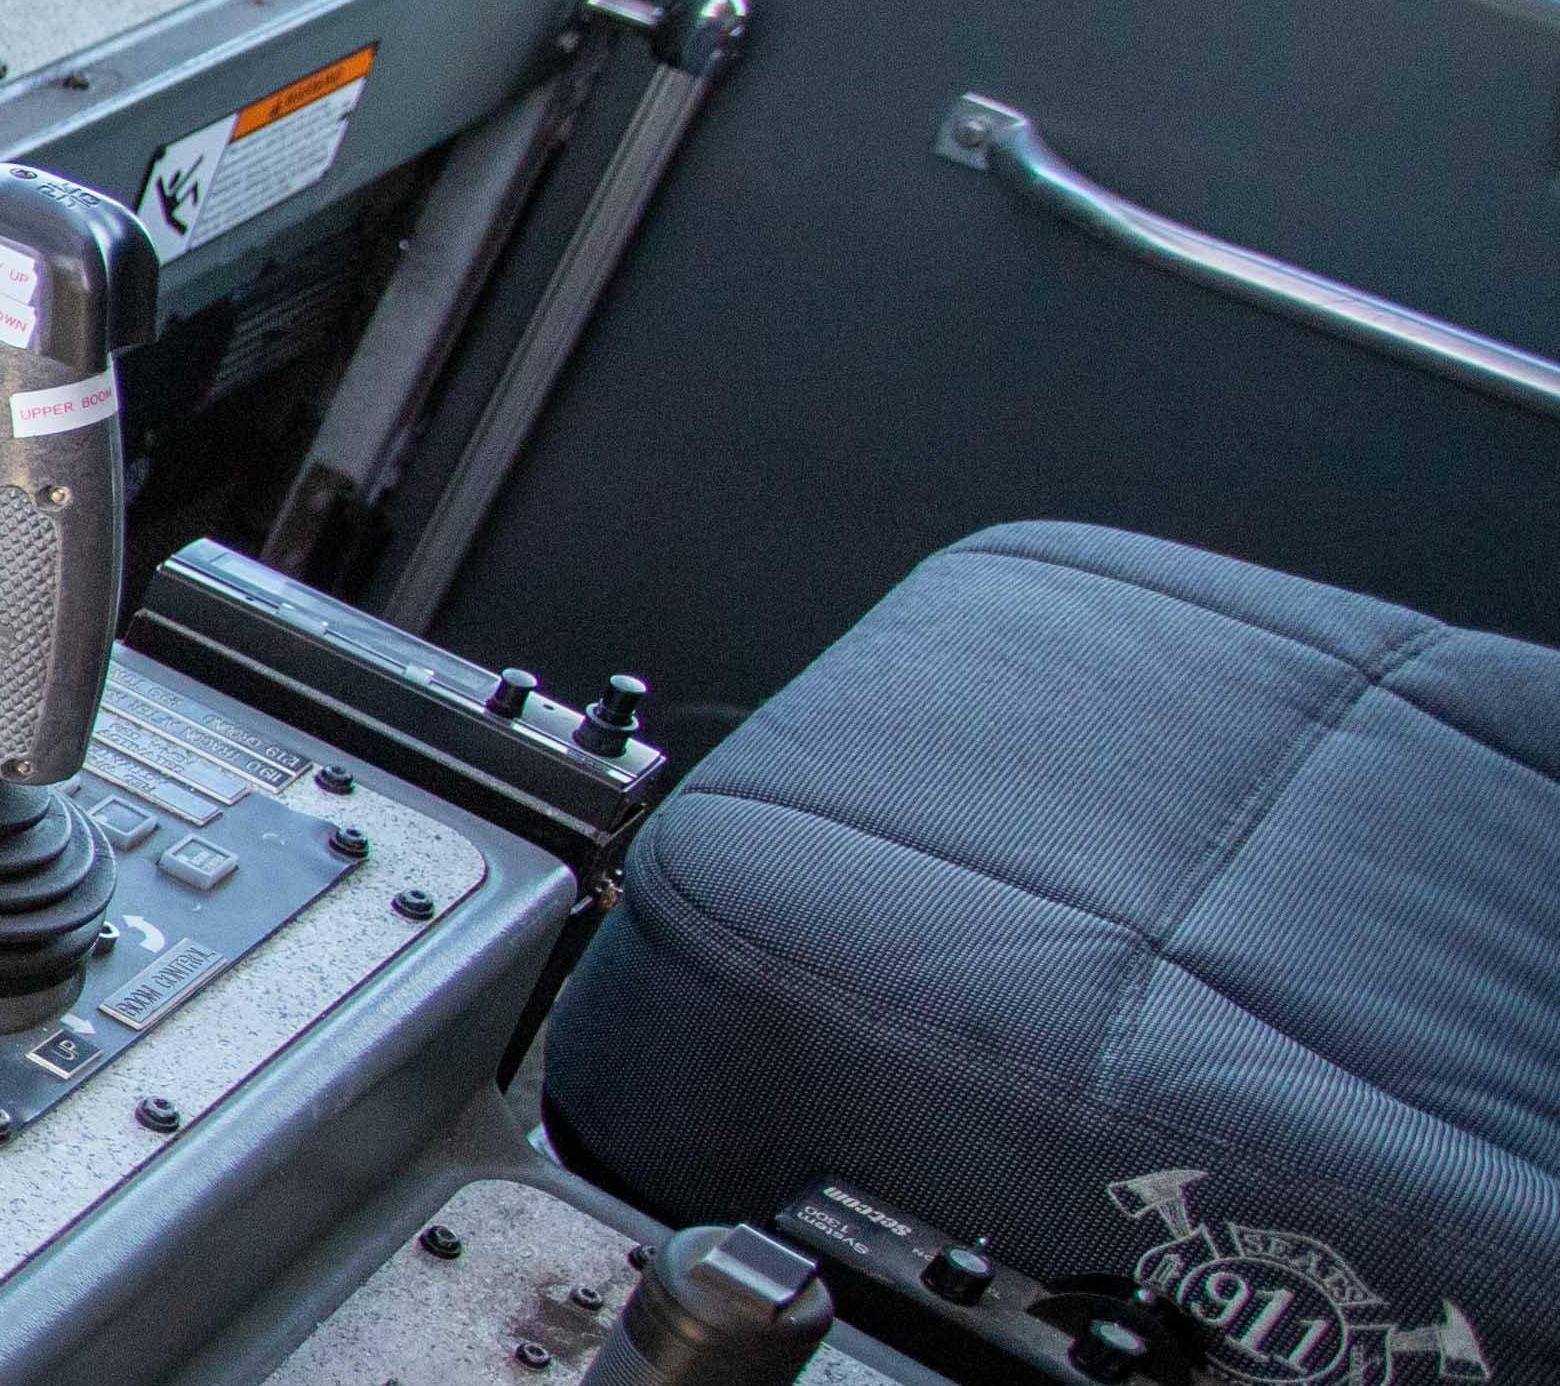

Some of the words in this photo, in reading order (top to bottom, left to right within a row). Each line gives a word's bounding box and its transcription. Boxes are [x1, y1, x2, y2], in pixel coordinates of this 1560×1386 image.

[9, 268, 30, 285] UP
[20, 401, 74, 420] UPPER
[81, 388, 113, 409] BOOM
[153, 945, 216, 989] CONTROL
[60, 1039, 79, 1061] UP
[805, 1205, 849, 1233] 1300
[1190, 1272, 1331, 1373] 911
